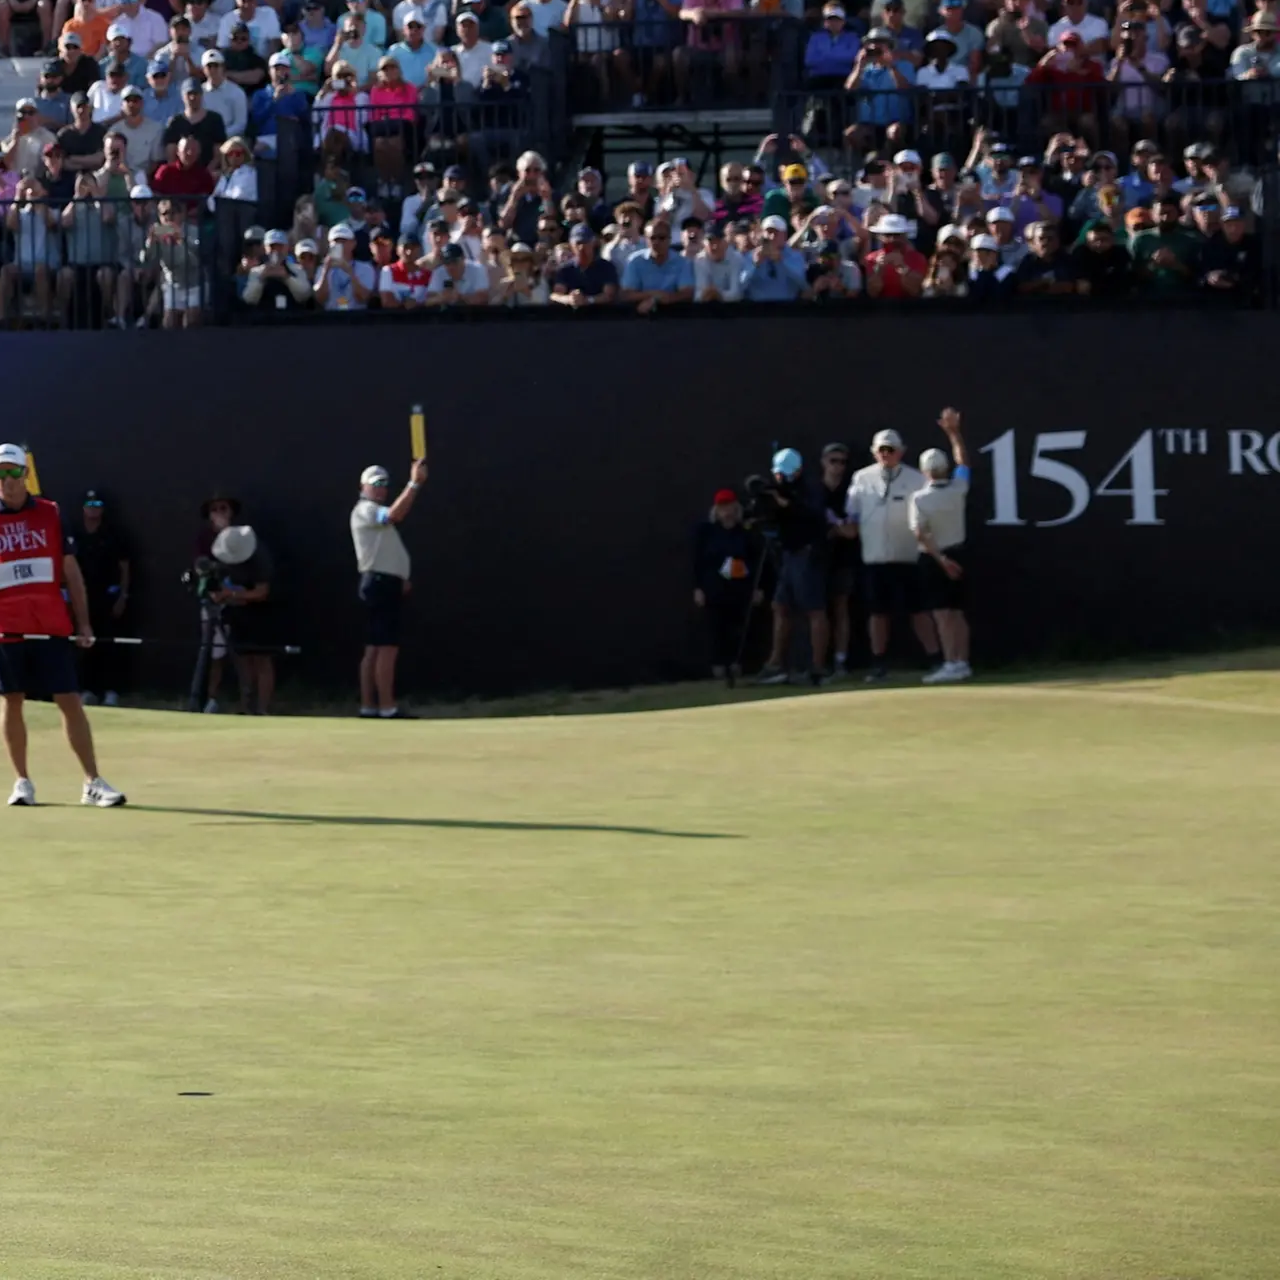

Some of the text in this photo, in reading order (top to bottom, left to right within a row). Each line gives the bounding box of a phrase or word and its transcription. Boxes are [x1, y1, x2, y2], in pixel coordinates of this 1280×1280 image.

[978, 429, 1208, 527] 154TH
[2, 521, 28, 537] THE
[13, 563, 34, 580] FOX
